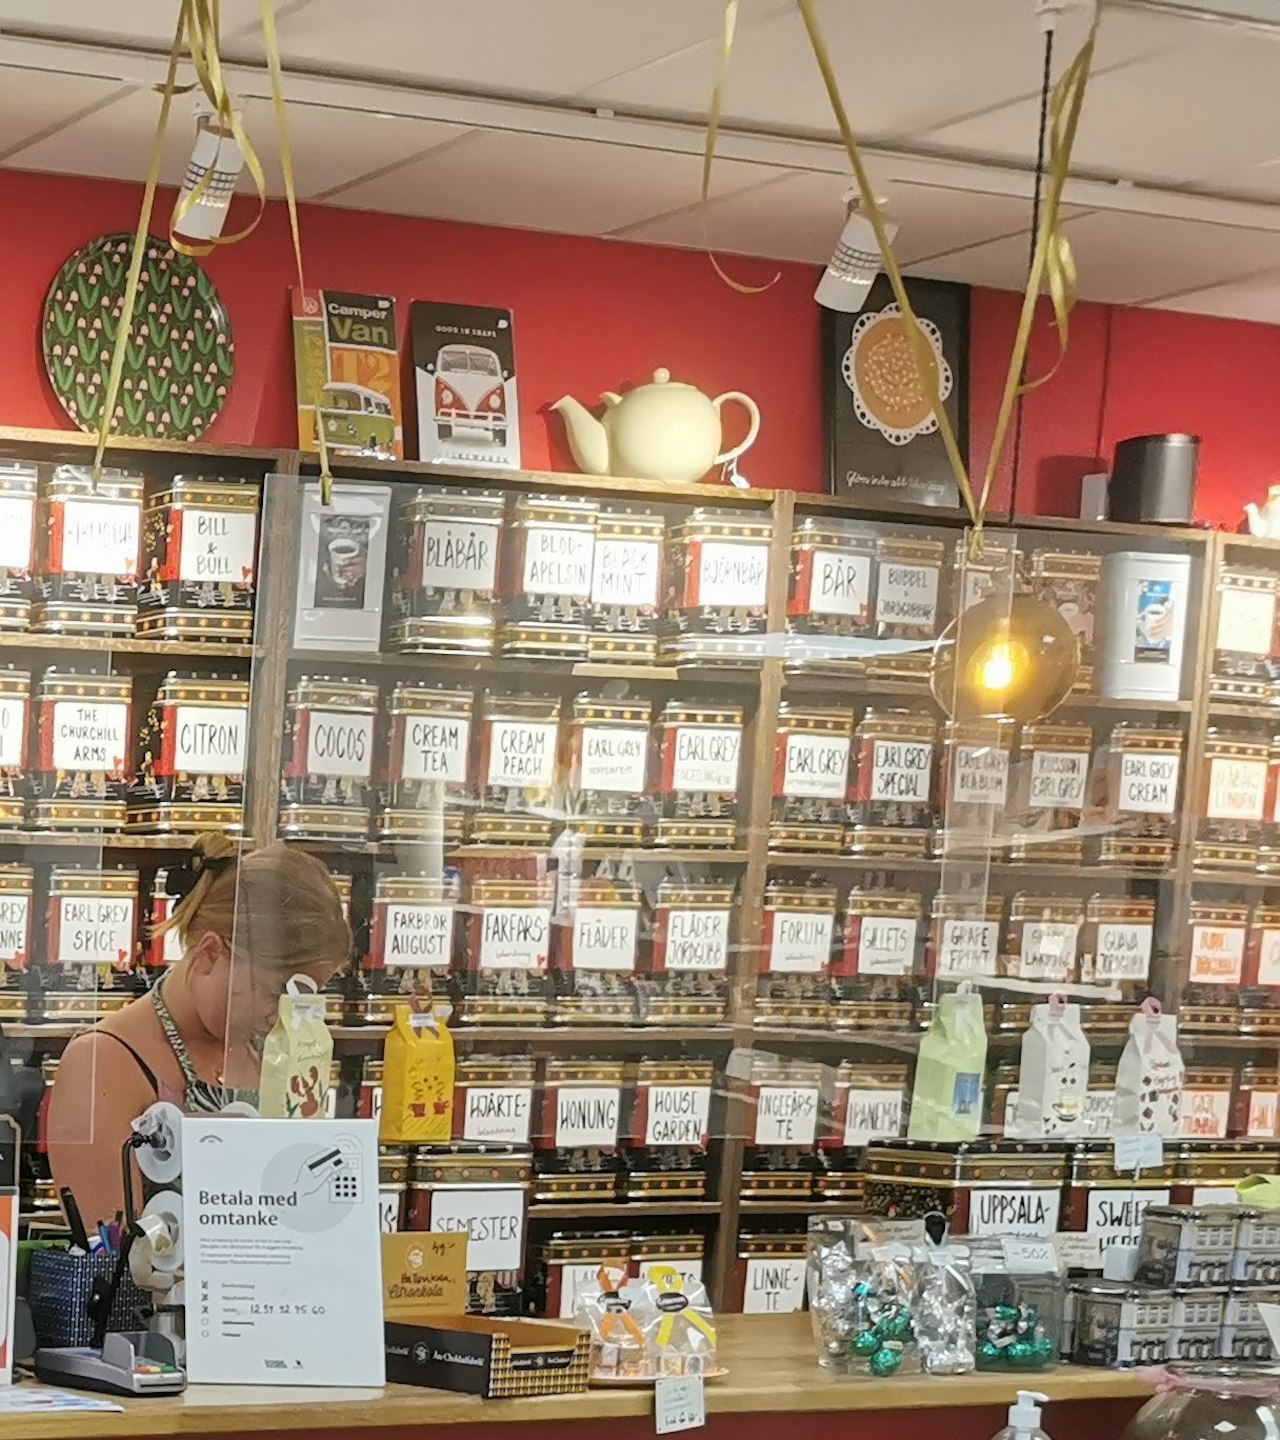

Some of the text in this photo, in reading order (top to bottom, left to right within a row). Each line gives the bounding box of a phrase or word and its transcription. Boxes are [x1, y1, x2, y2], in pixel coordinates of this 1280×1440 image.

[328, 302, 387, 320] Camper
[330, 316, 388, 345] Van
[198, 515, 230, 537] BILL
[197, 554, 233, 576] BULL
[821, 558, 858, 597] BÄR
[77, 708, 98, 722] THE
[60, 725, 119, 743] CHURCHILL
[180, 721, 238, 756] CITRON
[314, 723, 367, 761] COCOS
[412, 722, 459, 747] CREAM
[73, 744, 106, 762] ARMS
[679, 733, 741, 763] EARL GREY
[422, 748, 449, 774] TEA
[503, 753, 542, 776] PEACH
[1124, 758, 1174, 780] EARL GREY
[878, 773, 921, 797] SPECIAL
[1128, 780, 1168, 805] CREAM
[393, 913, 447, 932] FARBROR
[73, 928, 116, 953] SPICE
[392, 935, 446, 955] AUGUST
[654, 1090, 698, 1114] HOUSE
[560, 1099, 616, 1130] HONUNG
[653, 1118, 703, 1143] GARDEN
[776, 1120, 794, 1141] TE
[199, 1190, 297, 1206] Betala med
[199, 1211, 278, 1226] omtanke
[766, 1292, 780, 1311] TE
